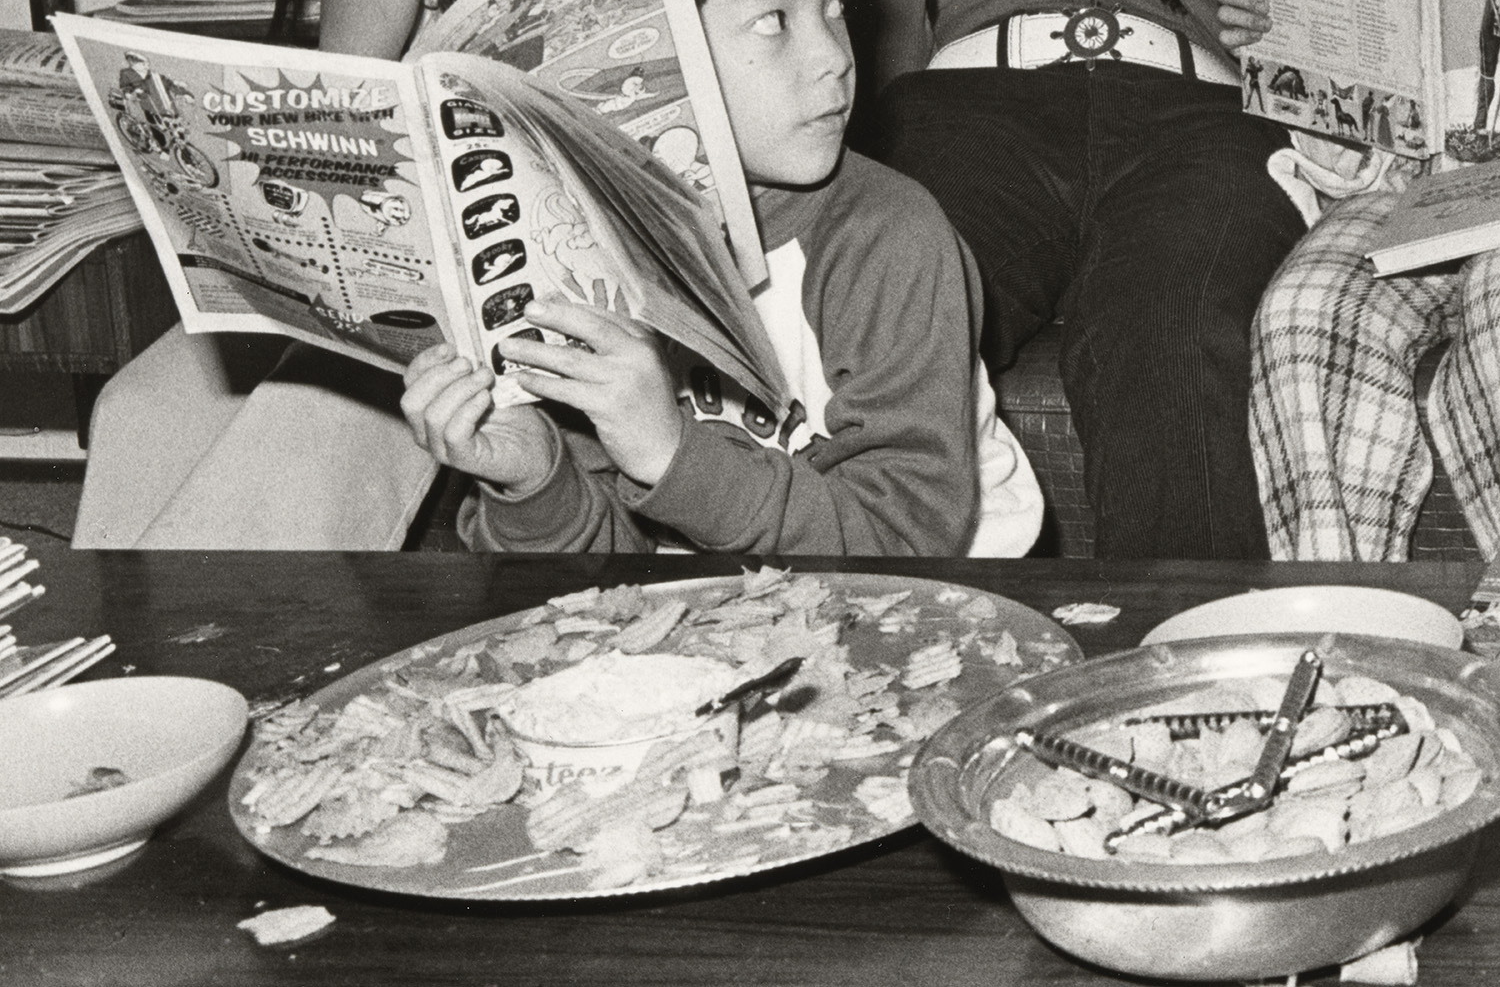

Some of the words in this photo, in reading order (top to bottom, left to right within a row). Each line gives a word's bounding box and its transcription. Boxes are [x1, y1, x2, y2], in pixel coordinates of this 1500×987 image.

[203, 86, 389, 114] CUSTOMIZE
[206, 113, 254, 127] YOUR
[259, 110, 300, 126] NEW
[304, 109, 345, 124] BIKE
[246, 126, 378, 158] SCHWINN
[240, 149, 400, 177] HI-PERFORMANCE
[259, 164, 381, 188] ACCESSORIES
[479, 241, 514, 262] Spooky
[483, 285, 532, 311] Wendy
[314, 306, 366, 325] SEND
